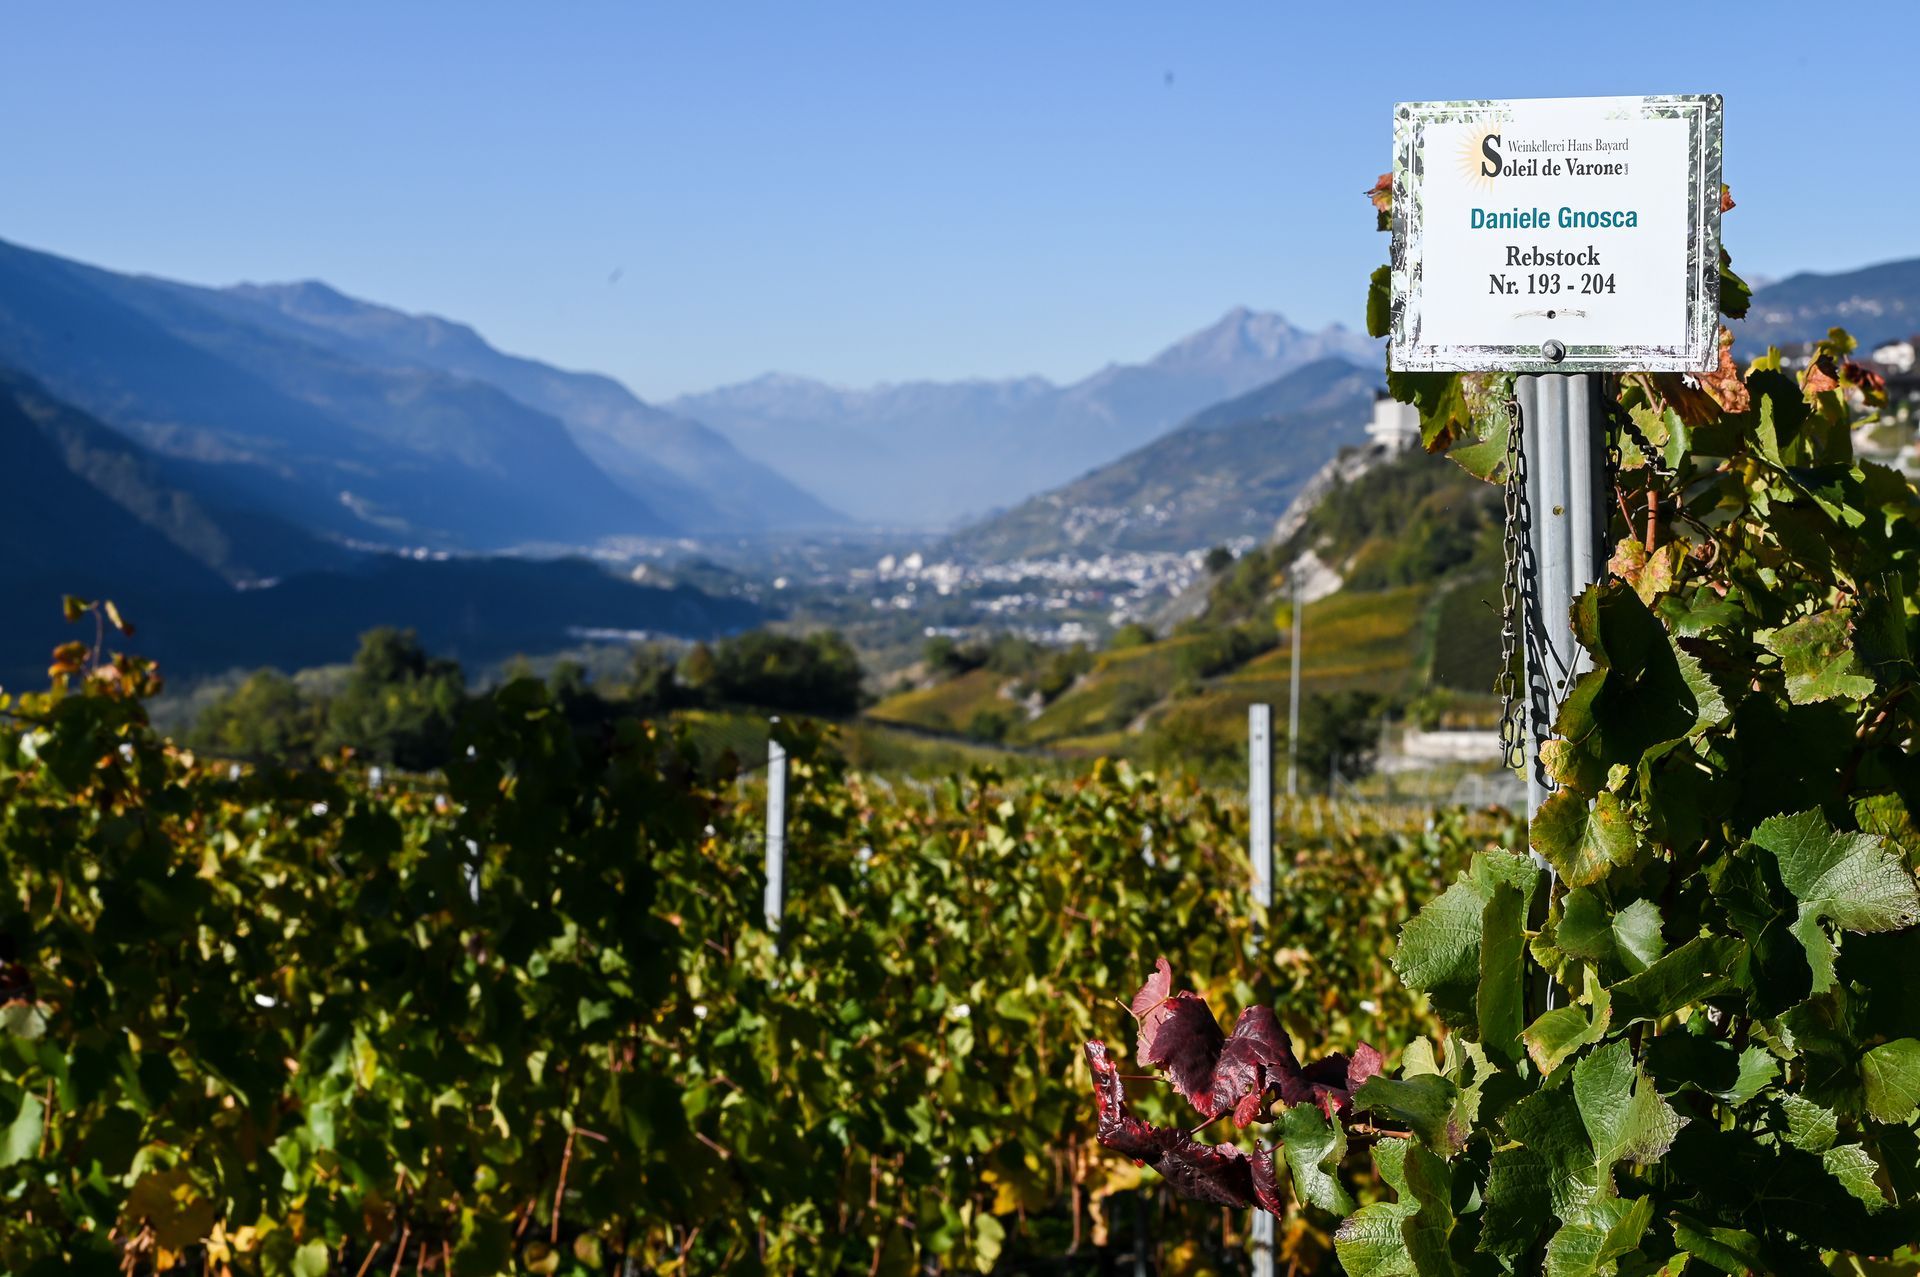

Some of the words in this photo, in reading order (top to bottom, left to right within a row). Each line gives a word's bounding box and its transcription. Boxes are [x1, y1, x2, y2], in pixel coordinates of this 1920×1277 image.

[1481, 134, 1538, 177] Soleil
[1542, 159, 1561, 176] de
[1566, 158, 1623, 176] Varone
[1508, 140, 1565, 152] Weinkellerei
[1567, 139, 1593, 151] Hans
[1595, 138, 1629, 154] Bayard
[1470, 207, 1550, 229] Daniele
[1558, 206, 1638, 228] Gnosca
[1505, 245, 1600, 266] Rebstock
[1489, 274, 1519, 294] Nr.
[1527, 273, 1560, 294] 193
[1580, 273, 1616, 294] 204
